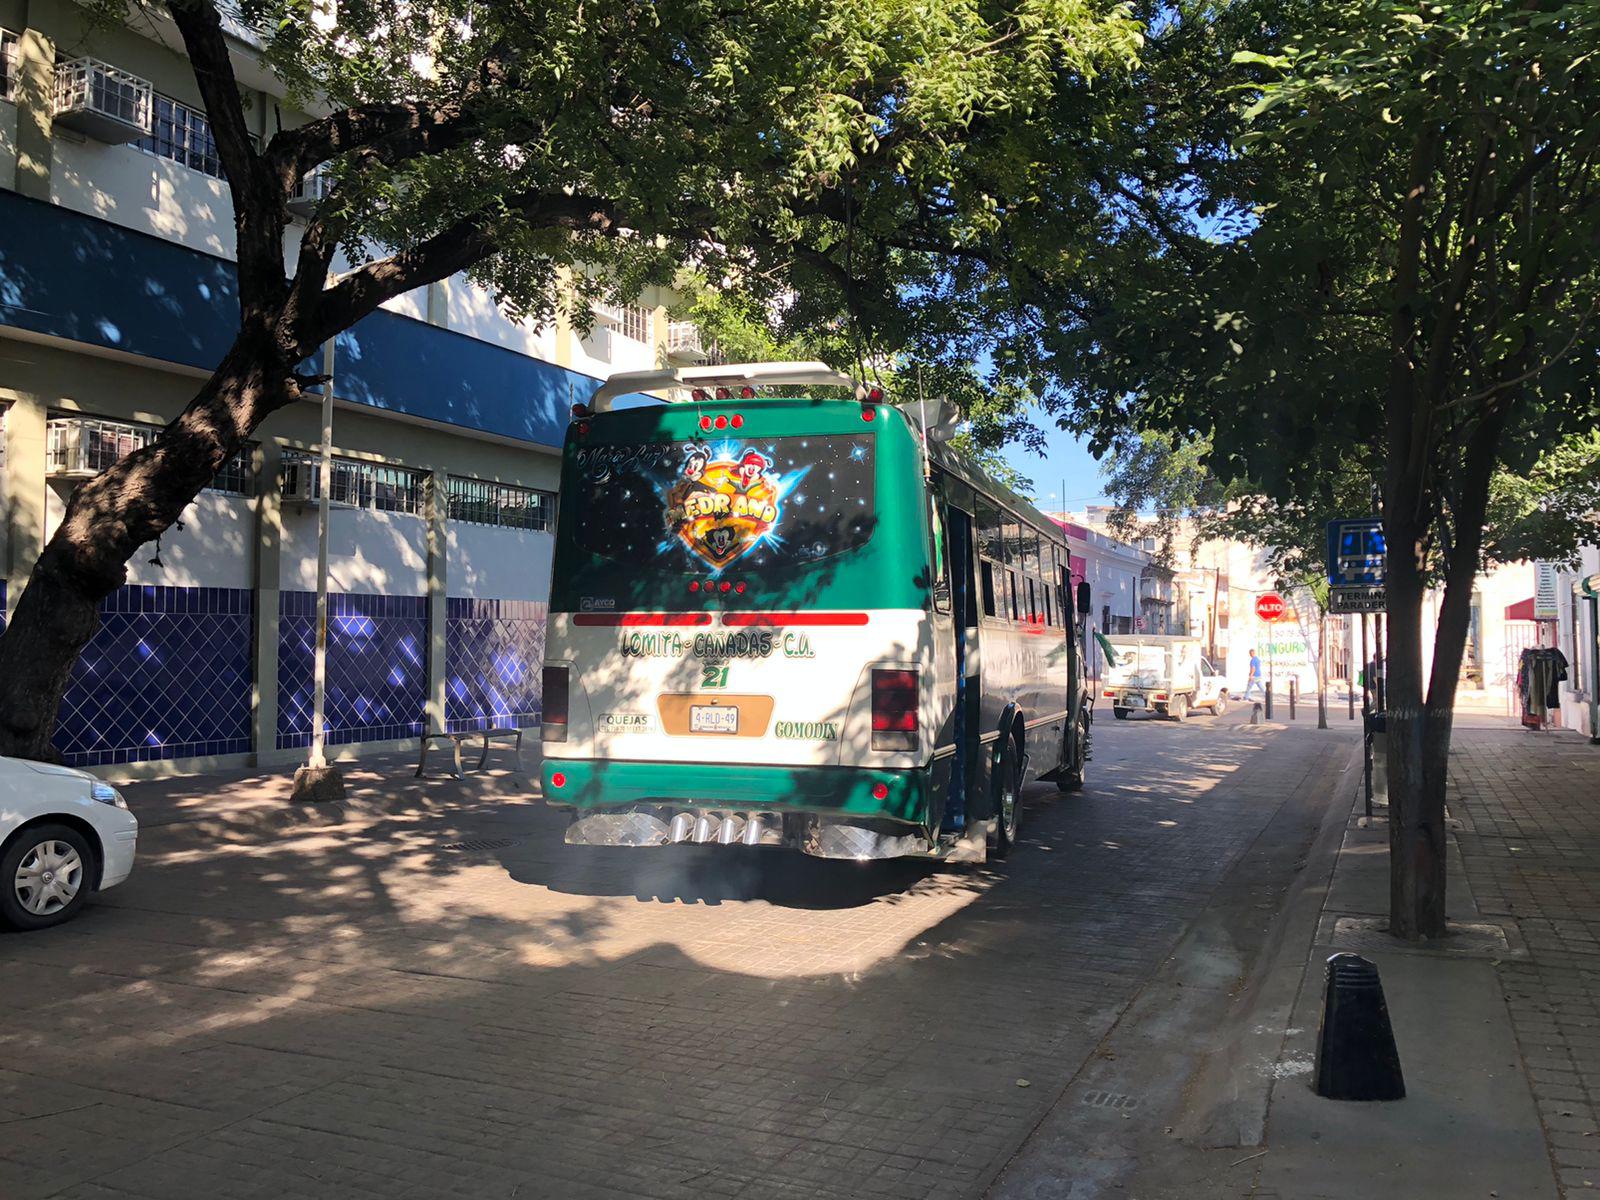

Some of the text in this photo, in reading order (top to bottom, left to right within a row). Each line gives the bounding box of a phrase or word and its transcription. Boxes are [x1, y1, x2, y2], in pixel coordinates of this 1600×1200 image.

[1259, 603, 1283, 612] ALTO
[701, 666, 730, 688] 21
[606, 715, 648, 725] QUEJAS
